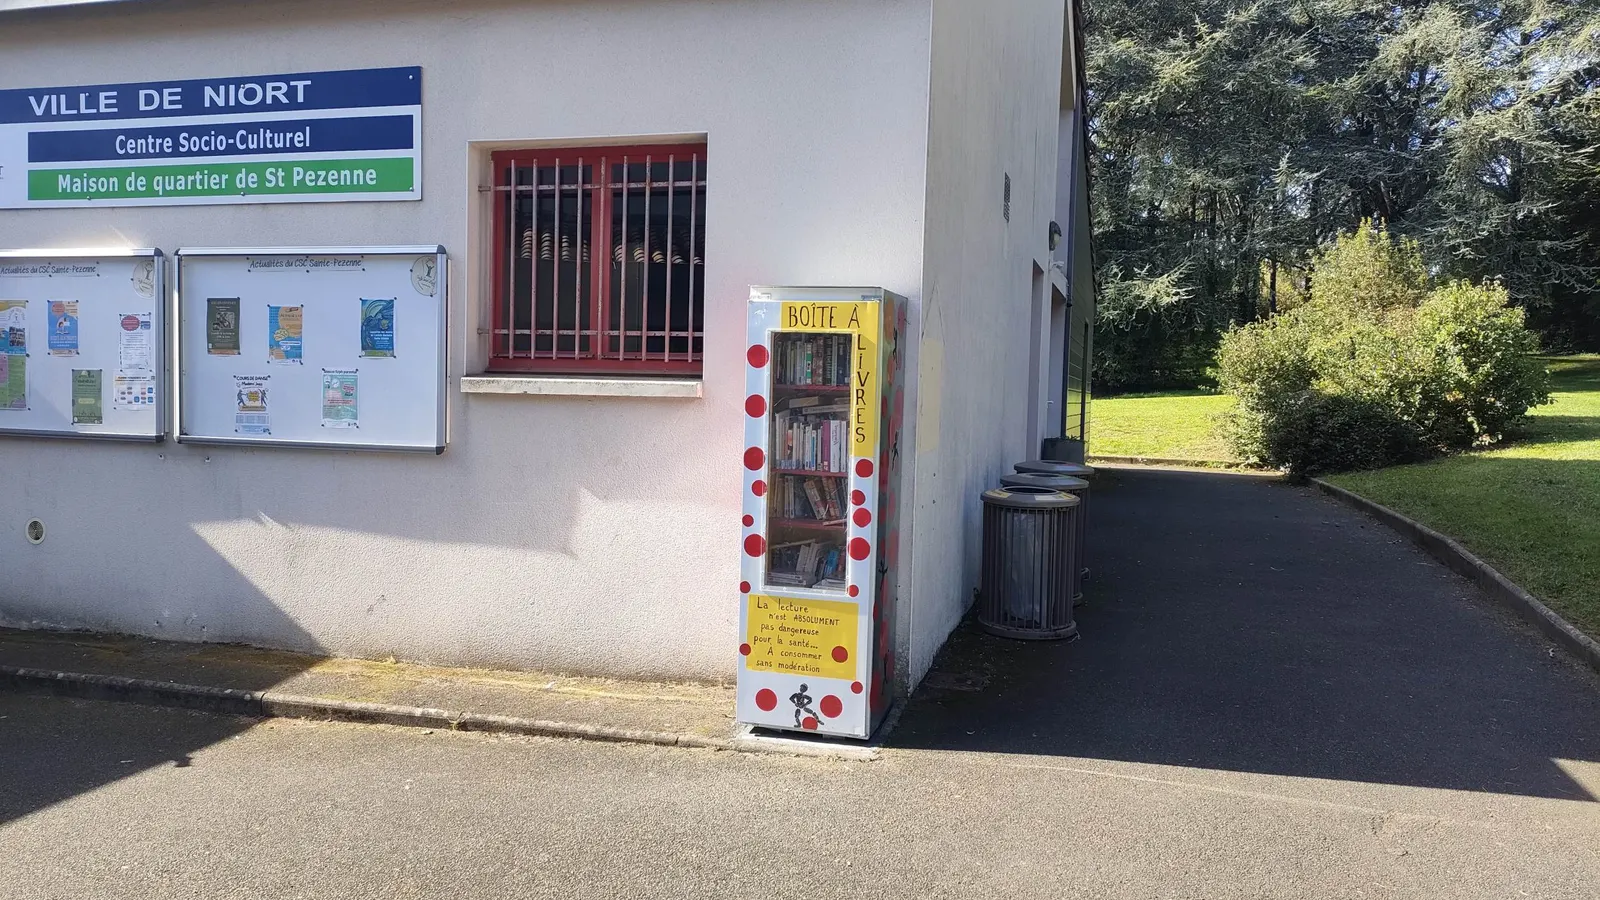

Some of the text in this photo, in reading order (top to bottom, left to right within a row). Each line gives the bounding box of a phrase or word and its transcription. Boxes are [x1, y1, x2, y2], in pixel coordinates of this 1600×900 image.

[28, 80, 311, 116] VILLE DE NIORT
[115, 127, 310, 155] Centre Socio-Culturel
[58, 165, 377, 196] Maison de quartier de St Pezenne
[0, 265, 29, 275] Actualités
[31, 266, 38, 274] du
[39, 265, 51, 274] CSC
[250, 258, 362, 269] Actualités du CSC Sainte-Pezenne
[788, 302, 861, 329] BOÎTE À
[757, 596, 809, 613] La lecture
[768, 613, 840, 626] n'est ABSOLUMENT
[760, 622, 819, 637] pas dangereuse
[753, 634, 819, 649] pour la santé...
[767, 642, 822, 660] À consommer
[756, 659, 820, 673] sans modération
